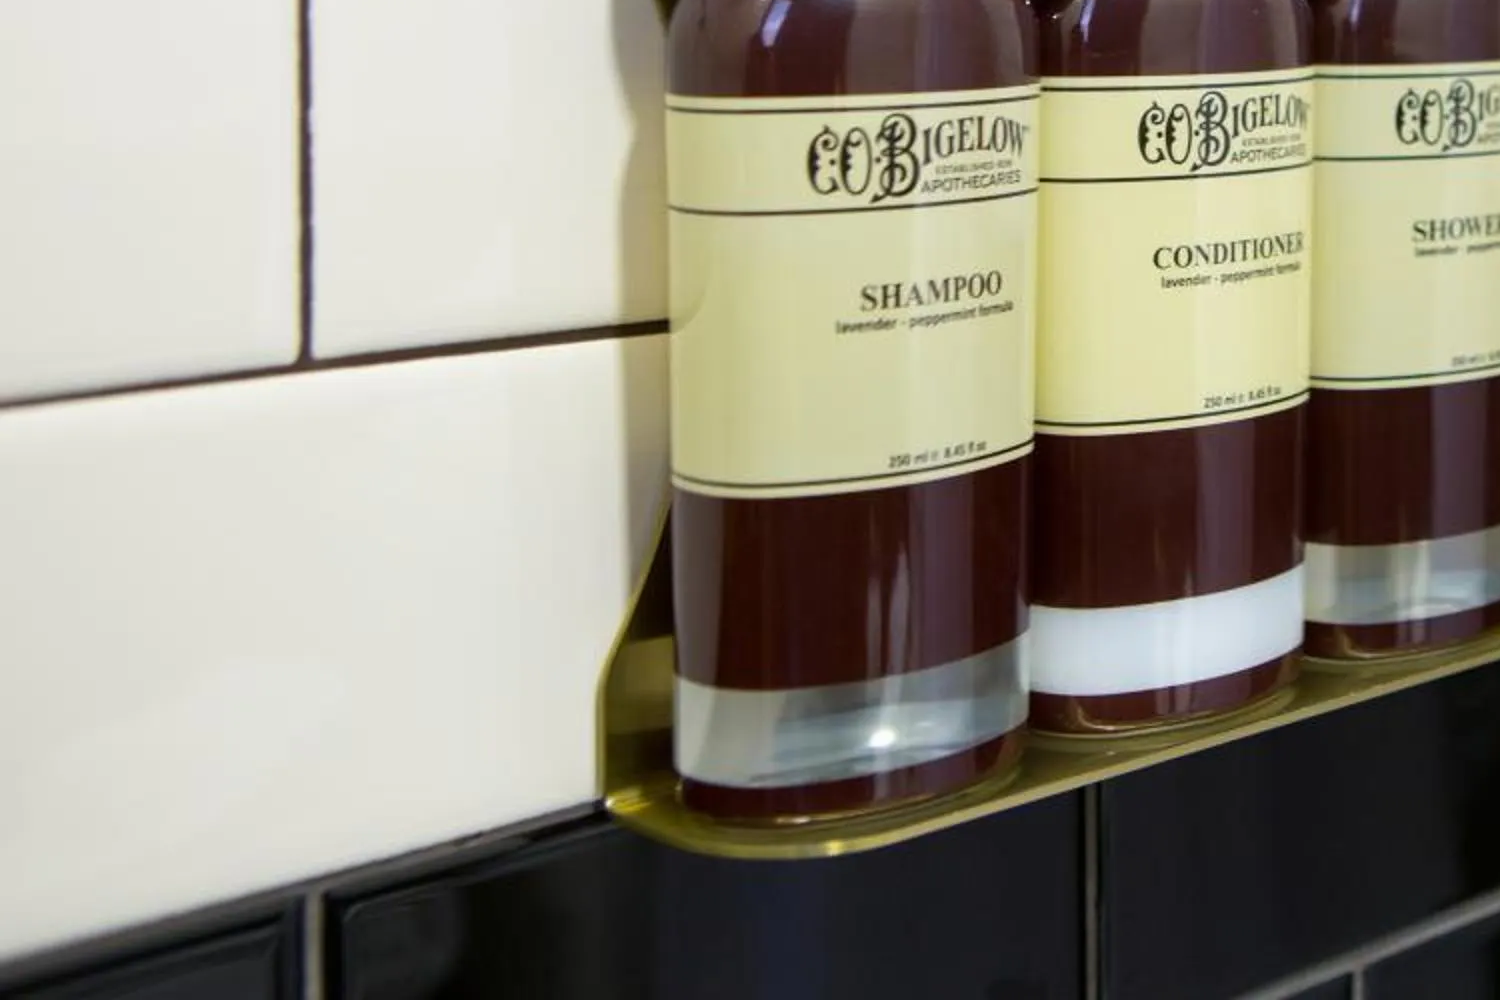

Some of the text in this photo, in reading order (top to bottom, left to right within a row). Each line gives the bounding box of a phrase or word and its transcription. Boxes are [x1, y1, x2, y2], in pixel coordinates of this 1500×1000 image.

[920, 169, 1021, 194] APOTHECARIES
[1153, 231, 1304, 270] CONDITIONER
[859, 269, 1003, 312] SHAMPOO
[1161, 273, 1212, 289] lavender
[835, 317, 897, 335] lavender
[908, 307, 976, 329] peppermint
